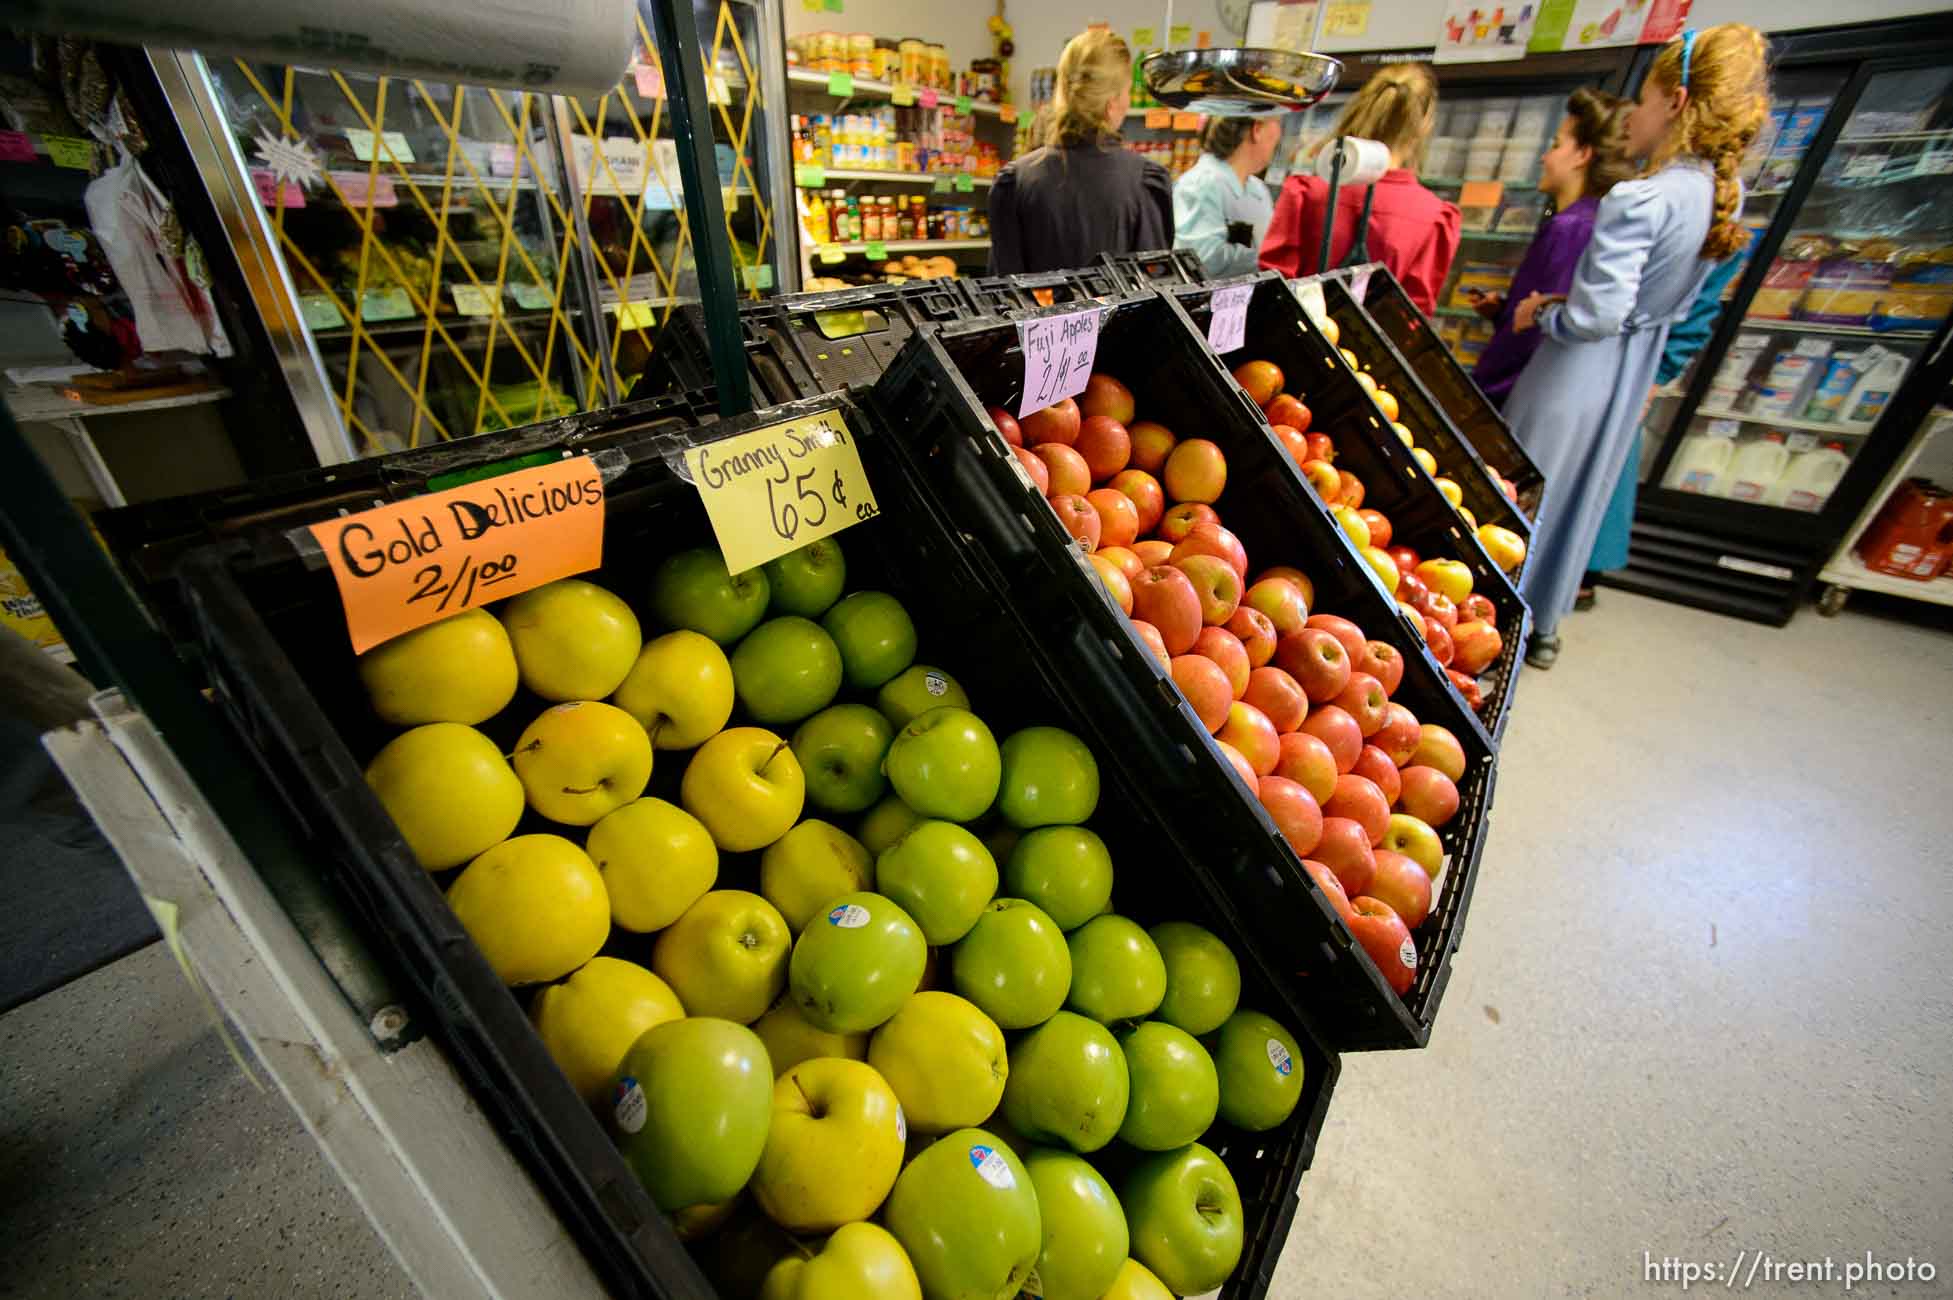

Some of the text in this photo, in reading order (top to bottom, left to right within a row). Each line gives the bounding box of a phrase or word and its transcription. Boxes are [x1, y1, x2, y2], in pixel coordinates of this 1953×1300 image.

[1027, 314, 1093, 363] Fuji Apples
[700, 419, 847, 489] Granny Smth
[339, 479, 602, 578] Gold Delicious
